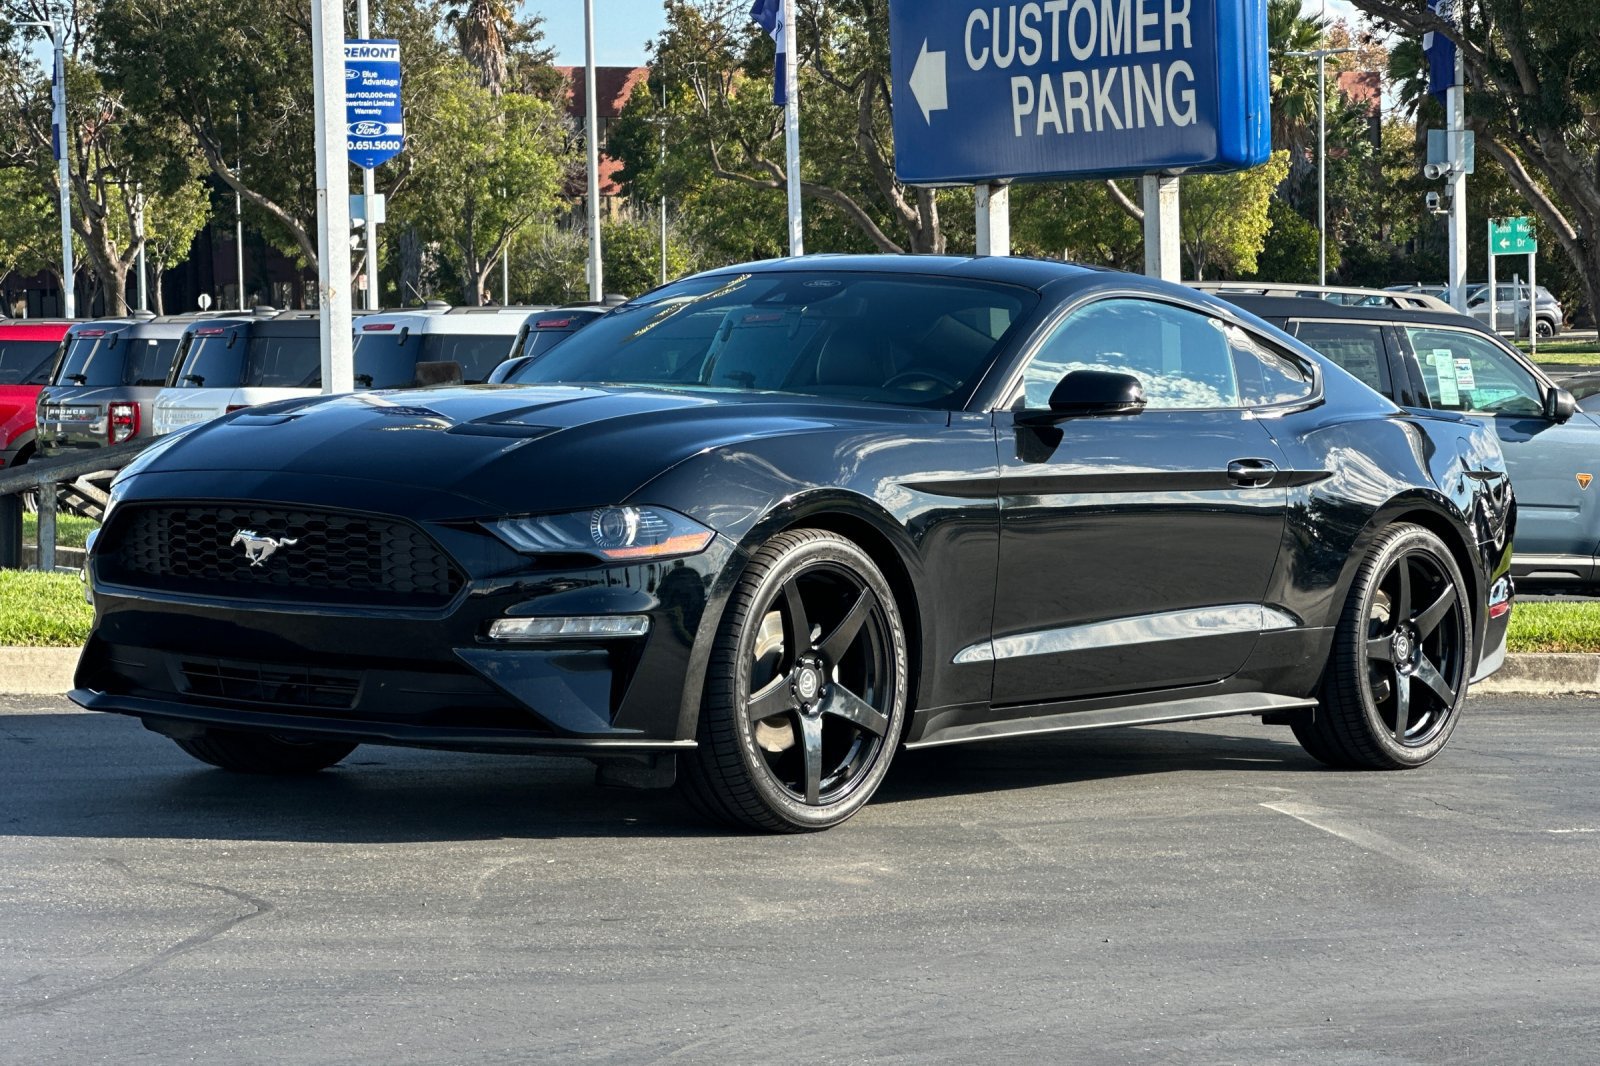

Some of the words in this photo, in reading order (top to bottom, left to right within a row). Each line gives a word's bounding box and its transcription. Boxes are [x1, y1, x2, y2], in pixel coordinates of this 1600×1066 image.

[965, 0, 1192, 71] CUSTOMER
[344, 47, 397, 58] REMONT
[362, 70, 378, 78] Blue
[362, 78, 398, 87] Advantage
[1011, 60, 1197, 137] PARKING
[355, 121, 381, 135] Ford
[347, 141, 400, 150] 0.651.5600
[1517, 238, 1525, 247] Dr
